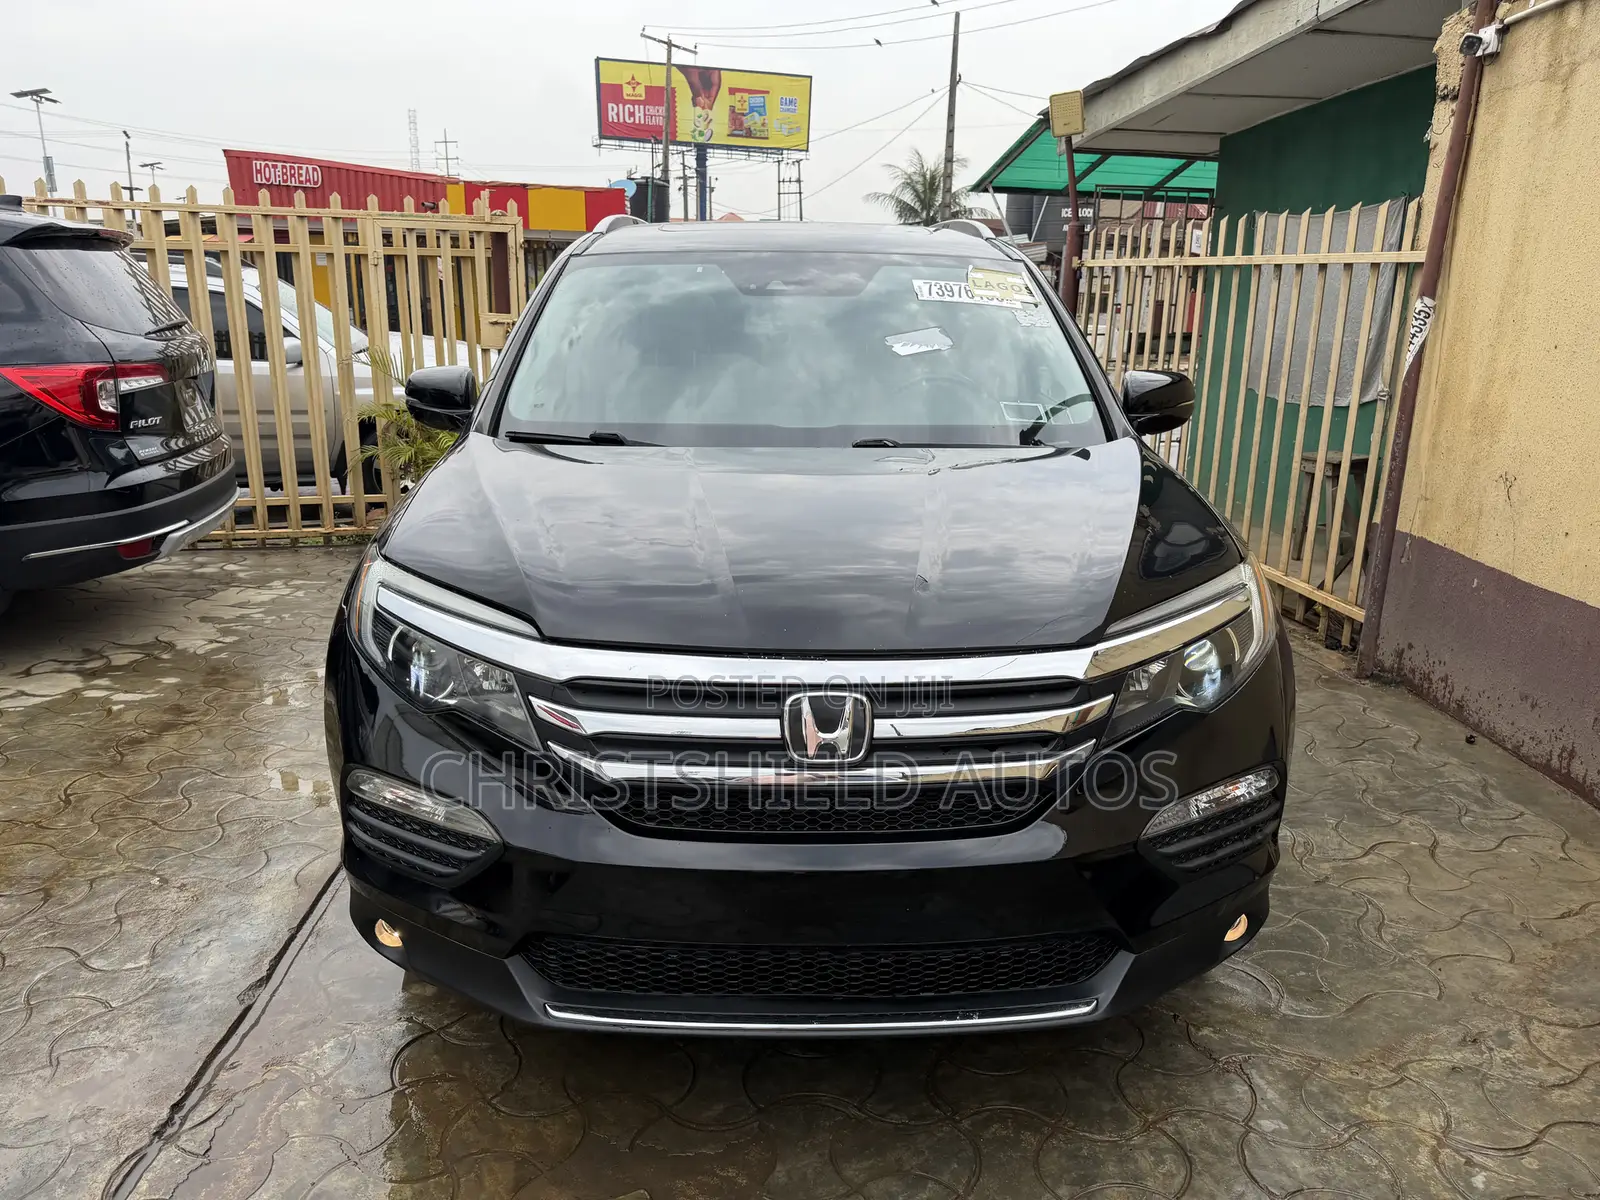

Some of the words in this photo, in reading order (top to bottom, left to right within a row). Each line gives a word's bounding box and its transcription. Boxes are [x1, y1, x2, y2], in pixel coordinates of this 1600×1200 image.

[780, 96, 798, 107] GAME
[608, 102, 645, 124] RICH
[645, 105, 665, 115] CHICK
[645, 115, 664, 126] FLAVO
[281, 164, 320, 187] BREAD
[1061, 208, 1072, 218] ICE
[1078, 208, 1093, 217] LOCK
[129, 416, 162, 429] PILOT
